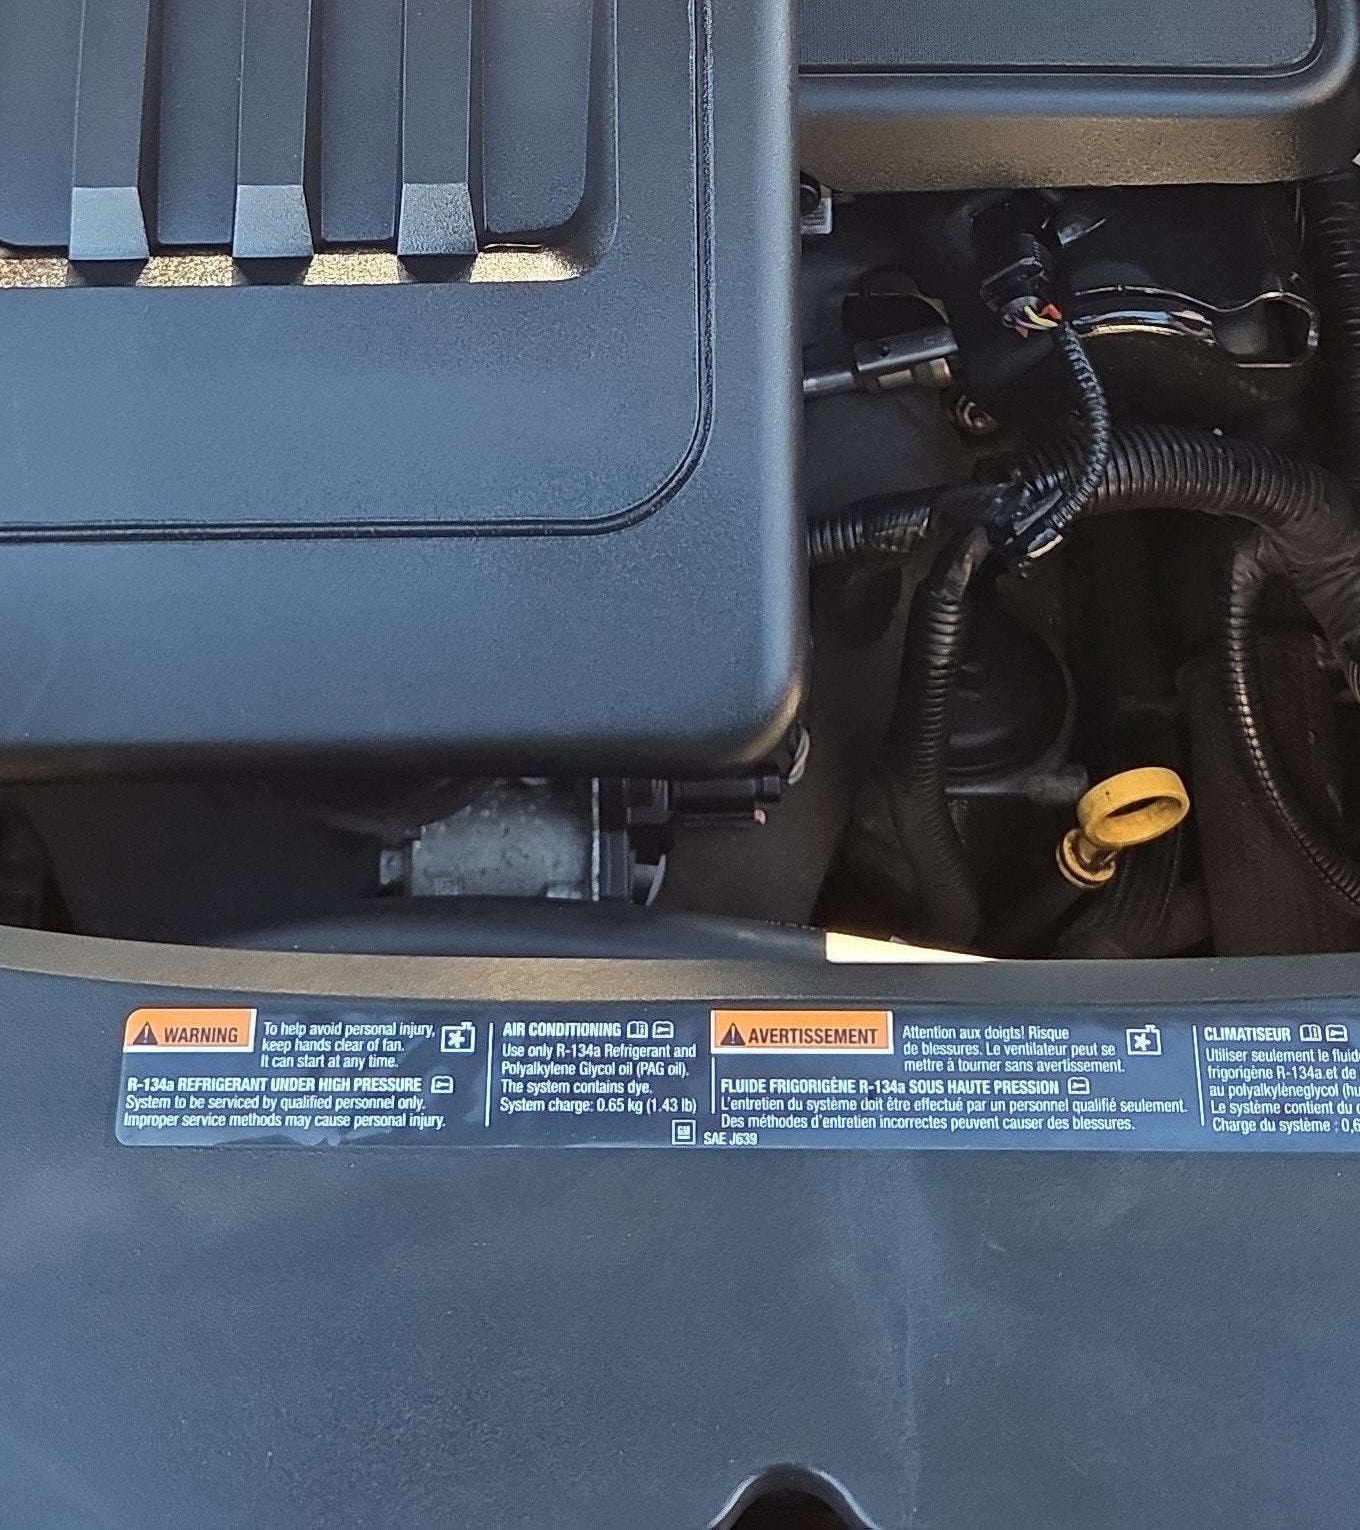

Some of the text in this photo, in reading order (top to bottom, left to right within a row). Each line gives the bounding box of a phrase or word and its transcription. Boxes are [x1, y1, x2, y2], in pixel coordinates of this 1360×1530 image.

[164, 1027, 238, 1043] WARNING
[264, 1022, 435, 1038] To help avoid personal injury,
[503, 1022, 621, 1037] AIR CONDITIONING
[749, 1028, 877, 1043] AVERTISSEMENT
[903, 1025, 1069, 1042] Attention aux doigts! Risque
[1204, 1027, 1291, 1041] CLIMATISEUR
[262, 1038, 404, 1054] keep hands clear of fan.
[503, 1043, 696, 1060] Use only R-134a Refrigerant and
[904, 1041, 1115, 1058] de blessures. Le ventilateur peut se
[261, 1054, 398, 1070] It can start at any time.
[1206, 1048, 1248, 1062] Utiliser
[1252, 1048, 1315, 1062] seulement
[1318, 1049, 1329, 1062] le
[502, 1061, 689, 1078] Polyalkylene Glycol oil (PAG oil).
[905, 1057, 1125, 1072] mettre à tourner sans avertissement.
[1208, 1065, 1273, 1082] frigorigène
[1342, 1066, 1356, 1079] de
[127, 1078, 422, 1092] R-134a REFRIGERANT UNDER HIGH PRESSURE
[501, 1079, 652, 1096] The system contains dye.
[721, 1076, 1059, 1094] FLUIDE FRIGORIGÈNE R-134a SOUS HAUTE PRESSION
[1209, 1085, 1224, 1096] au
[1229, 1082, 1339, 1100] polyalkylèneglycol
[126, 1095, 425, 1112] System to be serviced by qualified personnel only.
[500, 1097, 696, 1114] System charge: 0.65 kg (1.43 lb)
[721, 1096, 1188, 1114] L'entretien du système doit être effectué par un personnel qualifié seulement.
[1211, 1100, 1226, 1114] Le
[1230, 1100, 1280, 1117] système
[1285, 1101, 1334, 1114] contient
[1337, 1100, 1353, 1114] du
[124, 1112, 445, 1130] Improper service methods may cause personal injury.
[722, 1114, 1135, 1132] Des méthodes d'entretien incorrectes peuvent causer des blessures.
[1213, 1117, 1256, 1135] Charge
[1260, 1117, 1275, 1131] du
[1279, 1117, 1331, 1135] système
[704, 1132, 758, 1146] SAE J639
